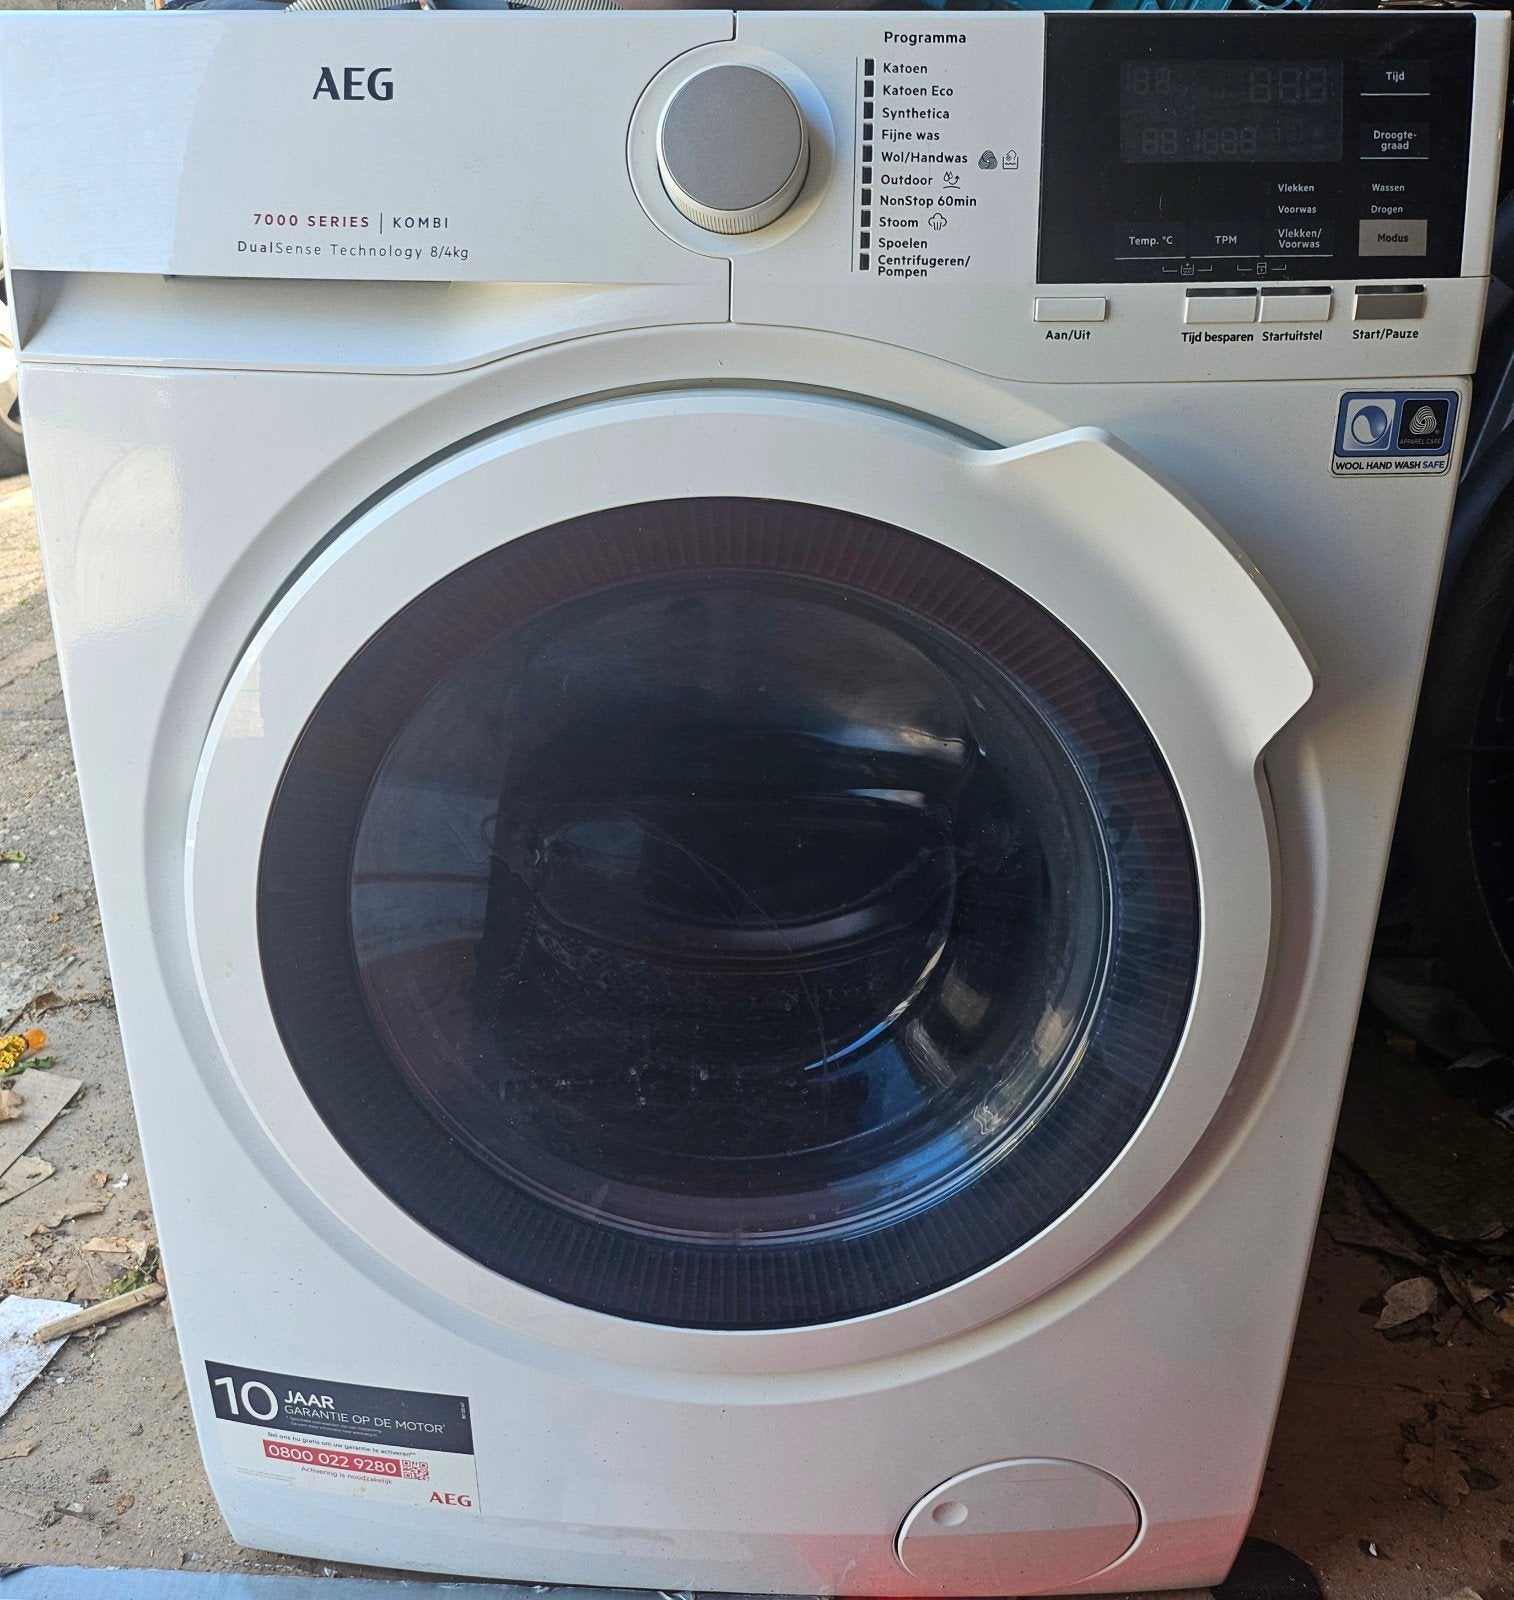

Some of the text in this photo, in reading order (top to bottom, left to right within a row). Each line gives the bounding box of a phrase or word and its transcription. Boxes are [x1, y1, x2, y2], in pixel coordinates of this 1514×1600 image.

[884, 31, 967, 45] Programma
[883, 62, 928, 74] Katoen
[1385, 71, 1405, 83] Tijd
[312, 66, 394, 101] AEG
[883, 85, 954, 97] Katoen Eco
[882, 107, 950, 120] Synthetica
[881, 129, 940, 142] Fijne was
[1373, 130, 1418, 142] Droogte-
[1380, 141, 1409, 152] graad
[881, 151, 968, 164] Wol/Handwas
[881, 174, 933, 186] Outdoor
[1278, 183, 1315, 192] Vlekken
[1371, 183, 1405, 192] Wassen
[880, 195, 977, 208] NonStop 60min
[1278, 205, 1317, 214] Voorwas
[1371, 205, 1403, 215] Drogen
[253, 213, 449, 229] 7000 SERIES KOMBI
[879, 216, 919, 228] Stoom
[1278, 228, 1322, 238] Vlekken/
[1377, 233, 1409, 243] Modus
[878, 238, 928, 251] Spoelen
[1129, 236, 1159, 247] Temp.
[1215, 235, 1237, 244] TPM
[1278, 240, 1320, 248] Voorwas
[237, 240, 469, 261] DualSense Technology 8/4kg
[878, 254, 970, 268] Centrifugeren/
[878, 267, 928, 279] Pompen
[1045, 330, 1091, 341] Aan/Uit
[1181, 331, 1254, 343] Tijd besparen
[1262, 330, 1323, 341] Startuitstel
[1352, 328, 1419, 341] Start/Pauze
[1335, 460, 1446, 470] WOOL HAND WASH SAFE
[214, 1376, 279, 1421] 10
[284, 1390, 335, 1410] JAAR
[284, 1405, 349, 1422] GARANTIE
[352, 1414, 371, 1425] OP
[374, 1417, 392, 1428] DE
[268, 1444, 397, 1474] 0800 022 9280
[301, 1466, 338, 1478] Activering
[347, 1474, 393, 1485] noodzakelijk
[429, 1491, 472, 1507] AEG
